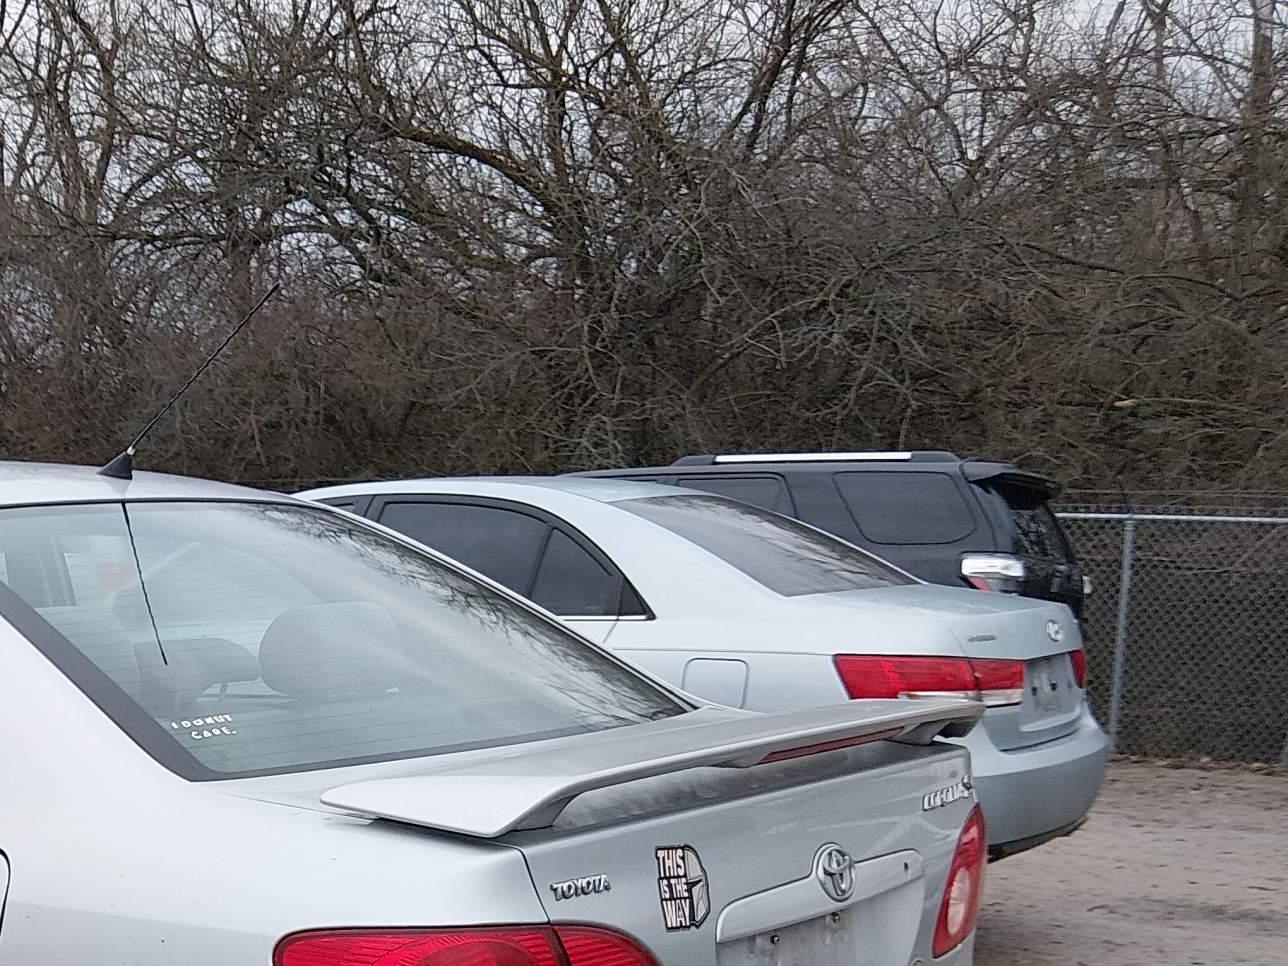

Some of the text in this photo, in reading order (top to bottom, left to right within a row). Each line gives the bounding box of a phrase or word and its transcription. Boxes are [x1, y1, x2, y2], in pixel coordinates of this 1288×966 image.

[180, 714, 233, 728] DONUT
[657, 848, 685, 878] THIS
[551, 874, 611, 900] TOYOTA
[660, 878, 688, 899] IS THE
[663, 899, 690, 928] WAY
